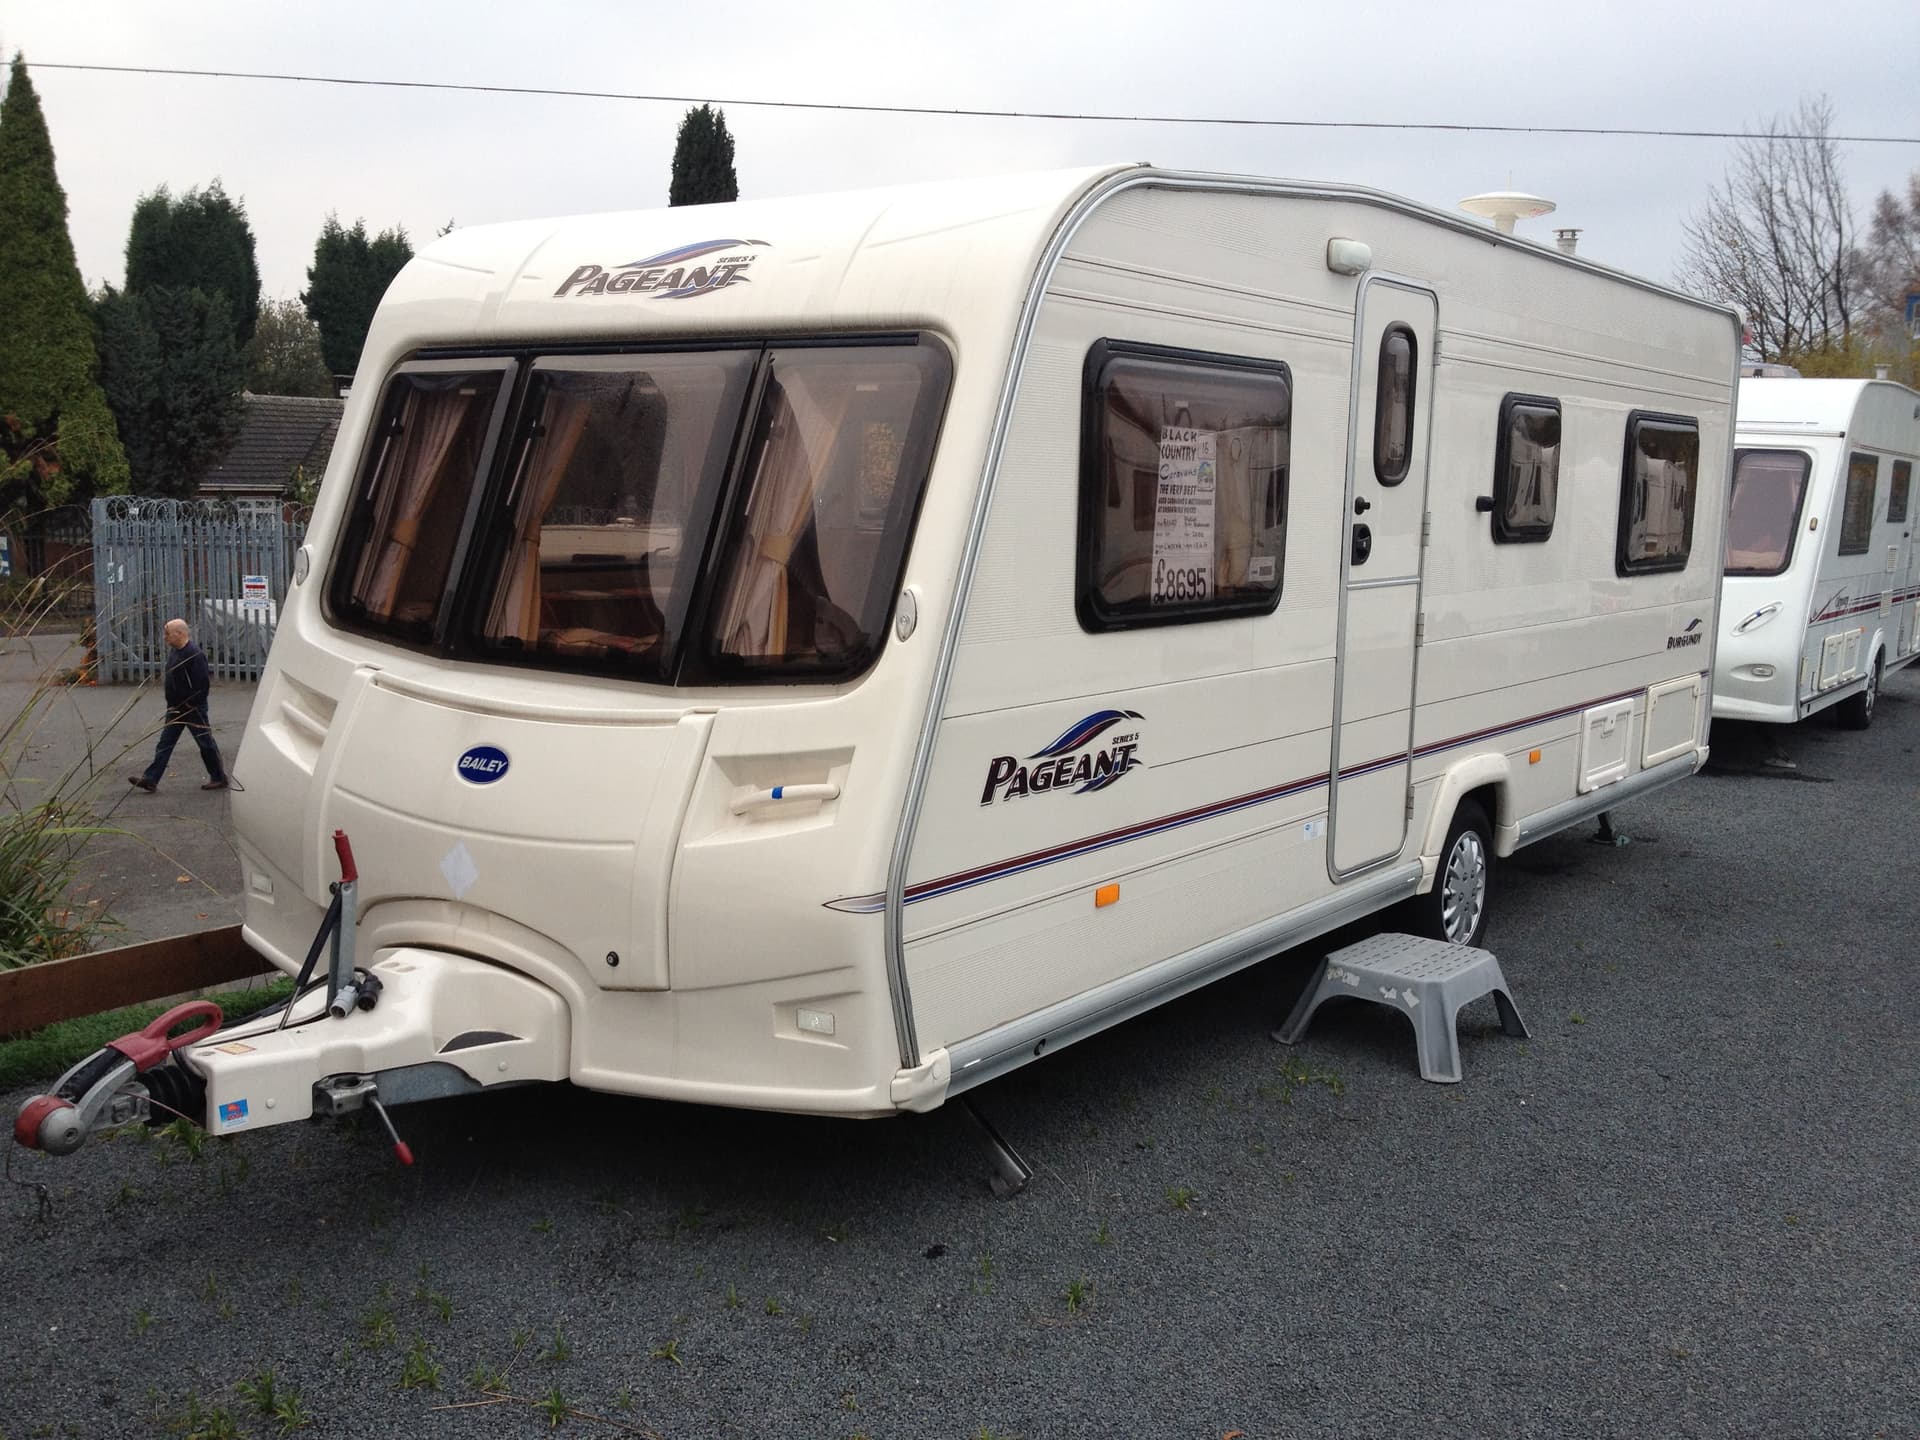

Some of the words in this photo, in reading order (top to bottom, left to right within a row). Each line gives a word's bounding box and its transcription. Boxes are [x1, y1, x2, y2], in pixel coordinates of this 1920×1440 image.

[716, 255, 749, 264] SERIES
[552, 264, 750, 298] PAGEANT
[1161, 427, 1197, 442] BLACK
[1161, 443, 1197, 461] COUNTRY
[1183, 484, 1197, 496] BEST
[1153, 558, 1206, 604] £8695
[1111, 734, 1134, 745] SERIES
[1134, 732, 1140, 741] 5
[459, 755, 508, 773] BAILEY
[980, 743, 1138, 807] PAGEANT
